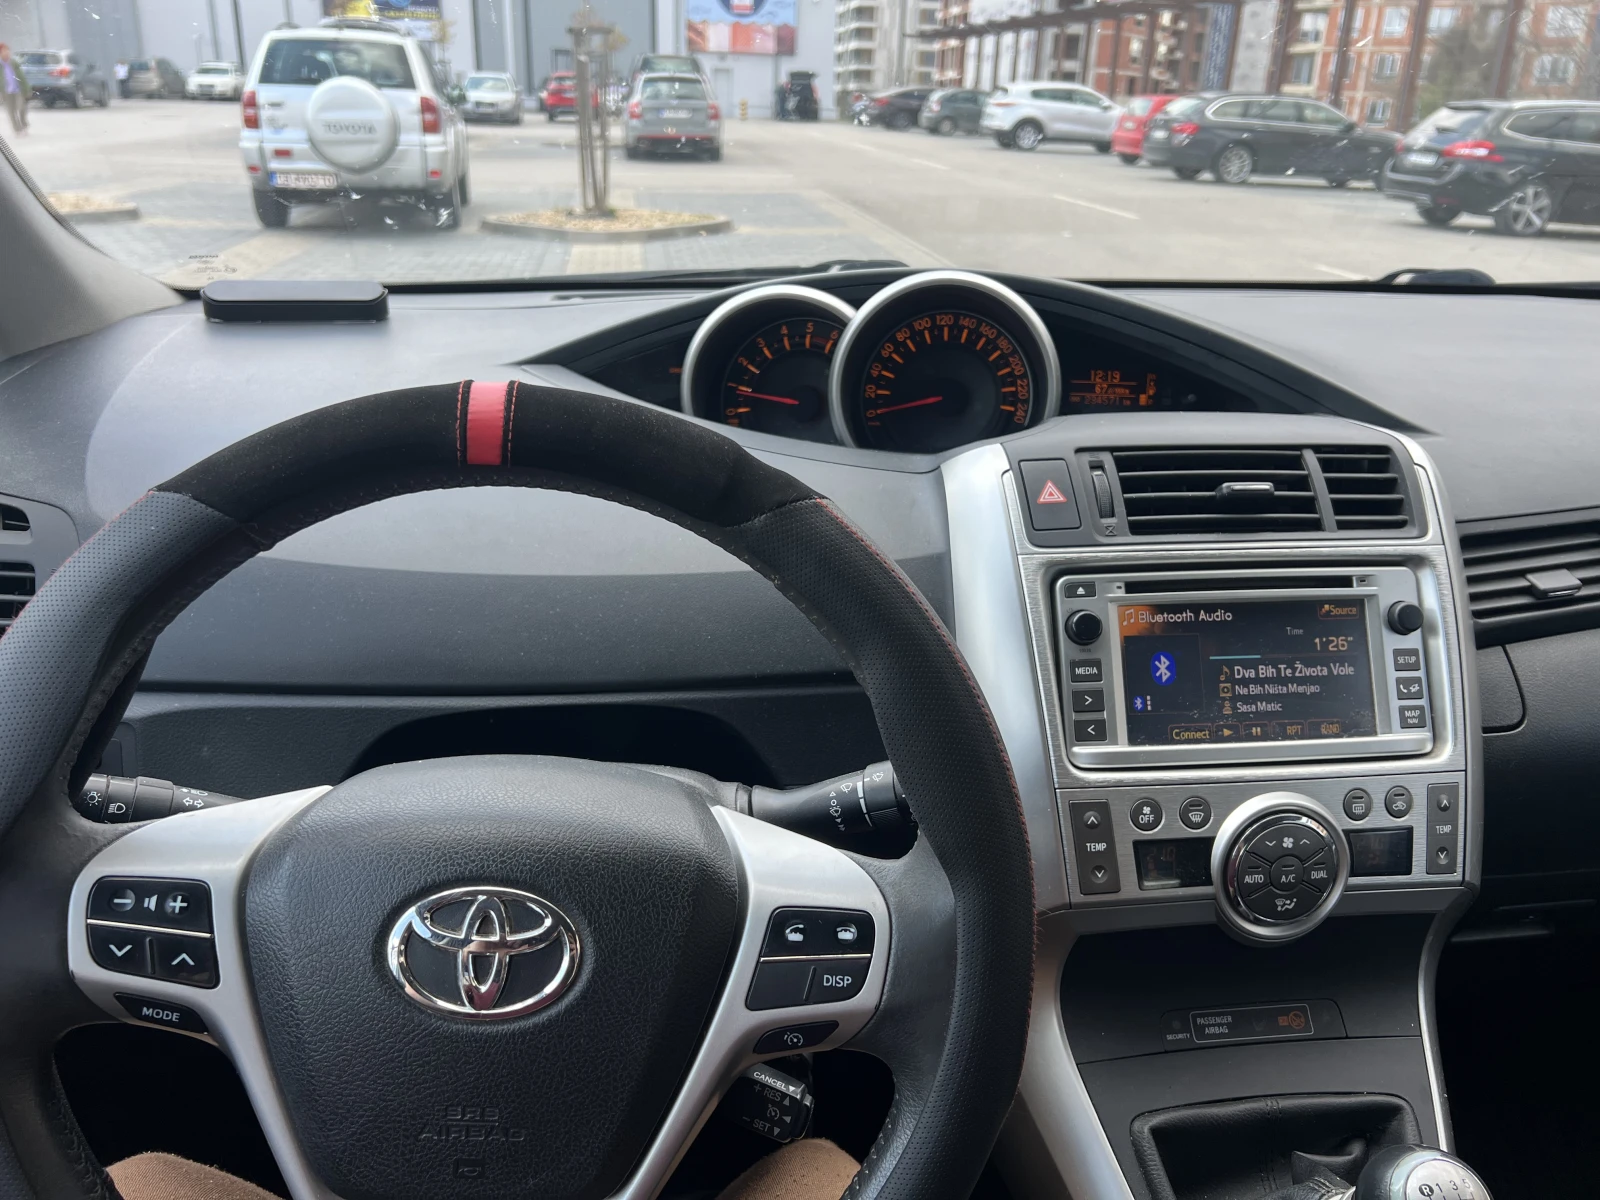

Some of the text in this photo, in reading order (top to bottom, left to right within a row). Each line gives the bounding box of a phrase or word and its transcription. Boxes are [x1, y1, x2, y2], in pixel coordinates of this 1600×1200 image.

[738, 357, 749, 367] 2
[756, 338, 766, 348] 3
[781, 324, 789, 334] 4
[806, 321, 815, 333] 5
[830, 329, 839, 340] 6
[865, 315, 1029, 424] 0 20 40 60 80 100 120 140 160 180 200 220 240
[1091, 370, 1121, 383] 12:19
[1330, 604, 1357, 615] Source
[1138, 609, 1233, 623] Bluetooth Audio
[1286, 627, 1304, 635] Time
[1397, 655, 1417, 664] SETUP
[1075, 666, 1098, 675] MEDIA
[1234, 661, 1355, 679] Dva Bih Te Života Vole
[1235, 685, 1249, 696] Ne
[1249, 684, 1264, 695] Bih
[1288, 683, 1321, 696] Menjao
[1236, 700, 1283, 713] Sasa Matic
[1404, 709, 1420, 718] MAP
[1172, 729, 1210, 740] Connect
[1286, 725, 1302, 736] RPT
[1138, 814, 1155, 824] OFF
[1436, 824, 1452, 834] TEMP
[1086, 843, 1107, 852] TEMP
[1244, 874, 1264, 883] AUTO
[1280, 874, 1296, 883] A/C
[1311, 870, 1328, 879] DUAL
[823, 974, 852, 988] DISP
[141, 1006, 181, 1022] MODE
[1196, 1015, 1233, 1026] PASSENGER
[1204, 1025, 1229, 1035] AIRBAG
[1166, 1033, 1191, 1041] SECURITY
[753, 1071, 787, 1091] CANCEL
[763, 1087, 782, 1102] RES
[752, 1118, 772, 1132] SET
[419, 1124, 525, 1141] AIRBAG
[1435, 1183, 1443, 1193] 1
[1449, 1179, 1459, 1191] 3
[1462, 1178, 1471, 1189] 5
